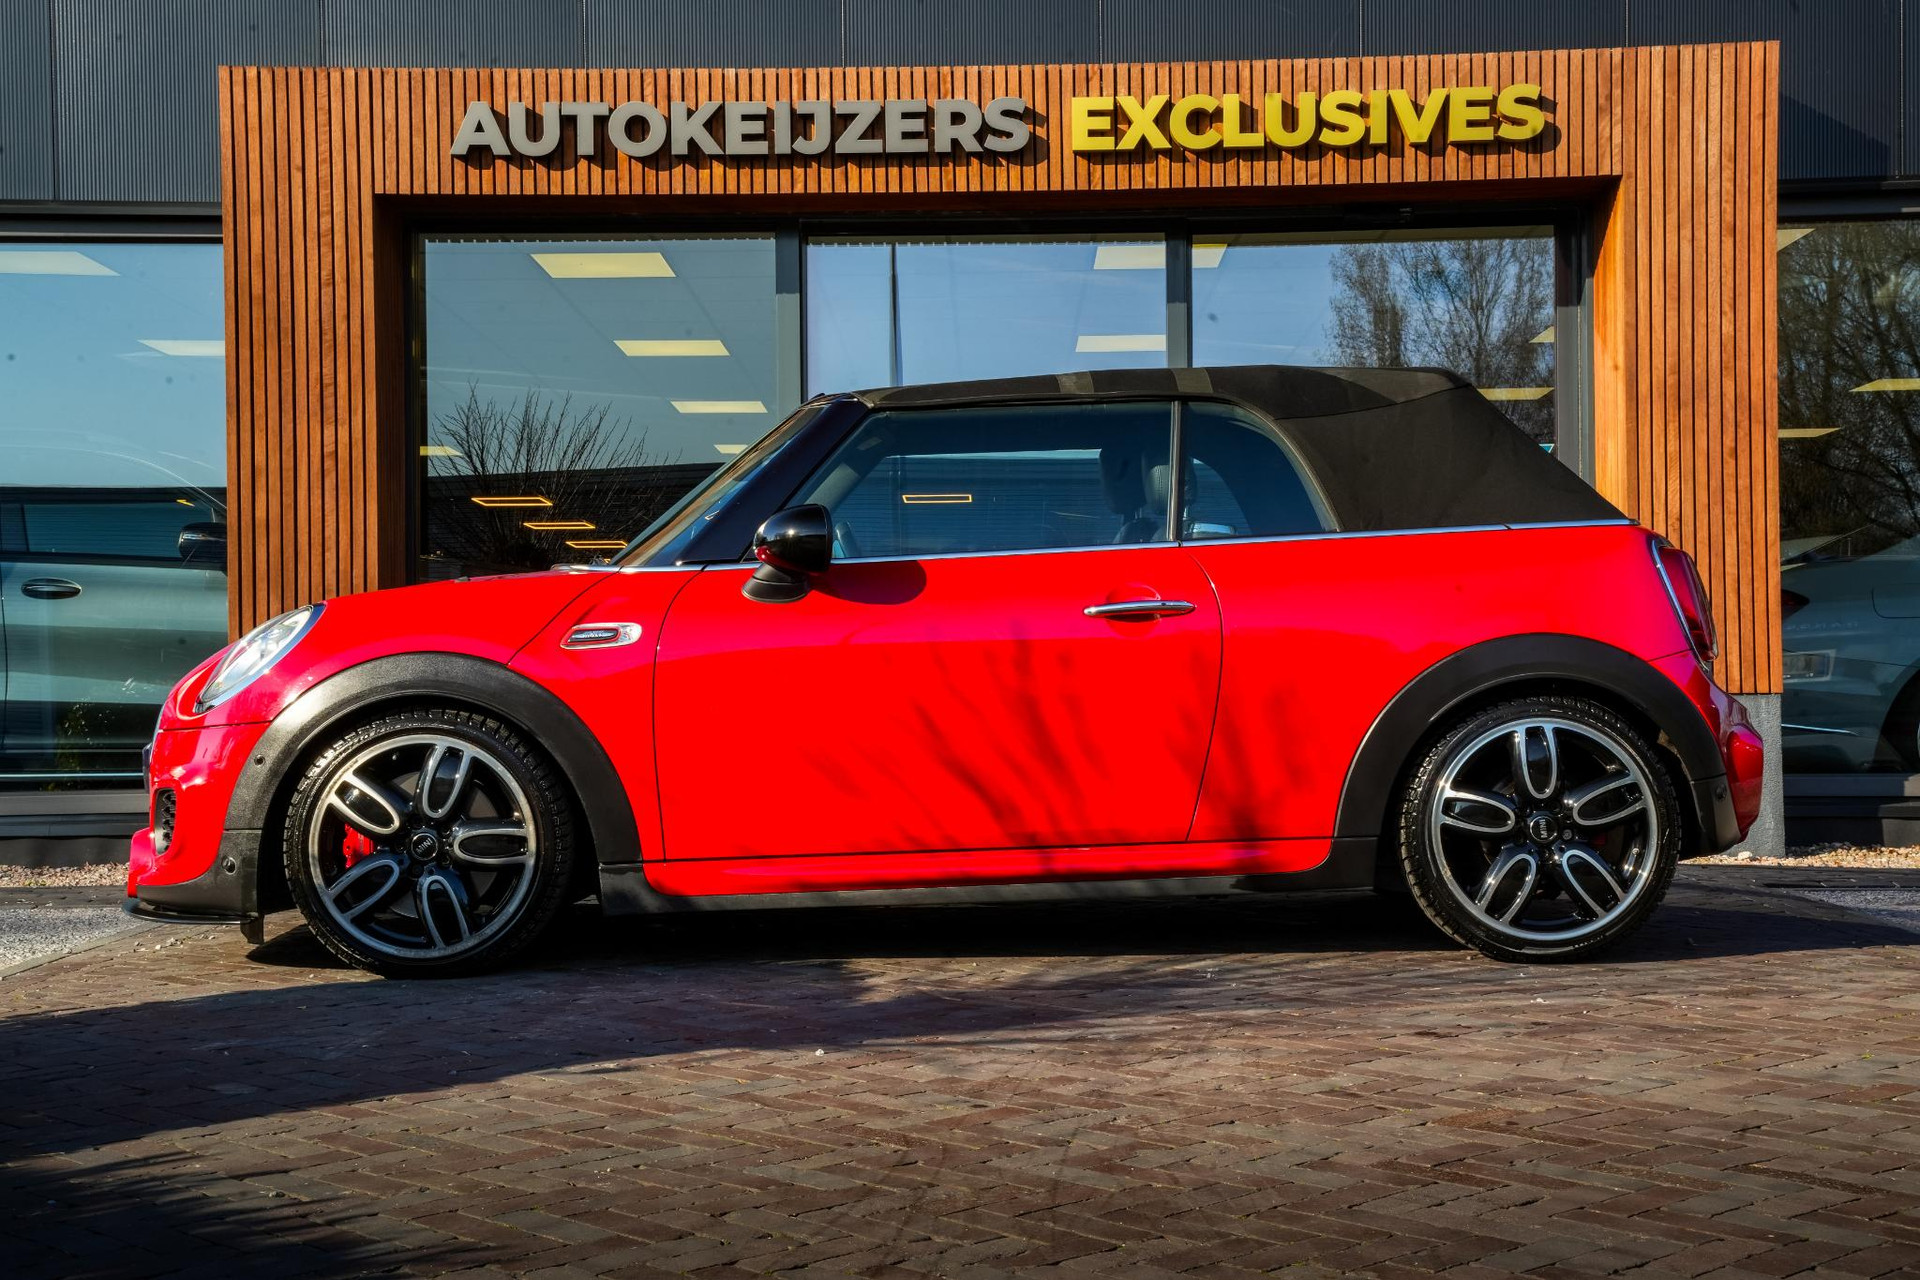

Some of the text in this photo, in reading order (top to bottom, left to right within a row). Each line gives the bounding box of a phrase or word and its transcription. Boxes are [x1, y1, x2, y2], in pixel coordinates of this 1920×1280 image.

[450, 83, 1546, 157] AUTOKEIJZERS EXCLUSIVES
[415, 837, 433, 853] MINI
